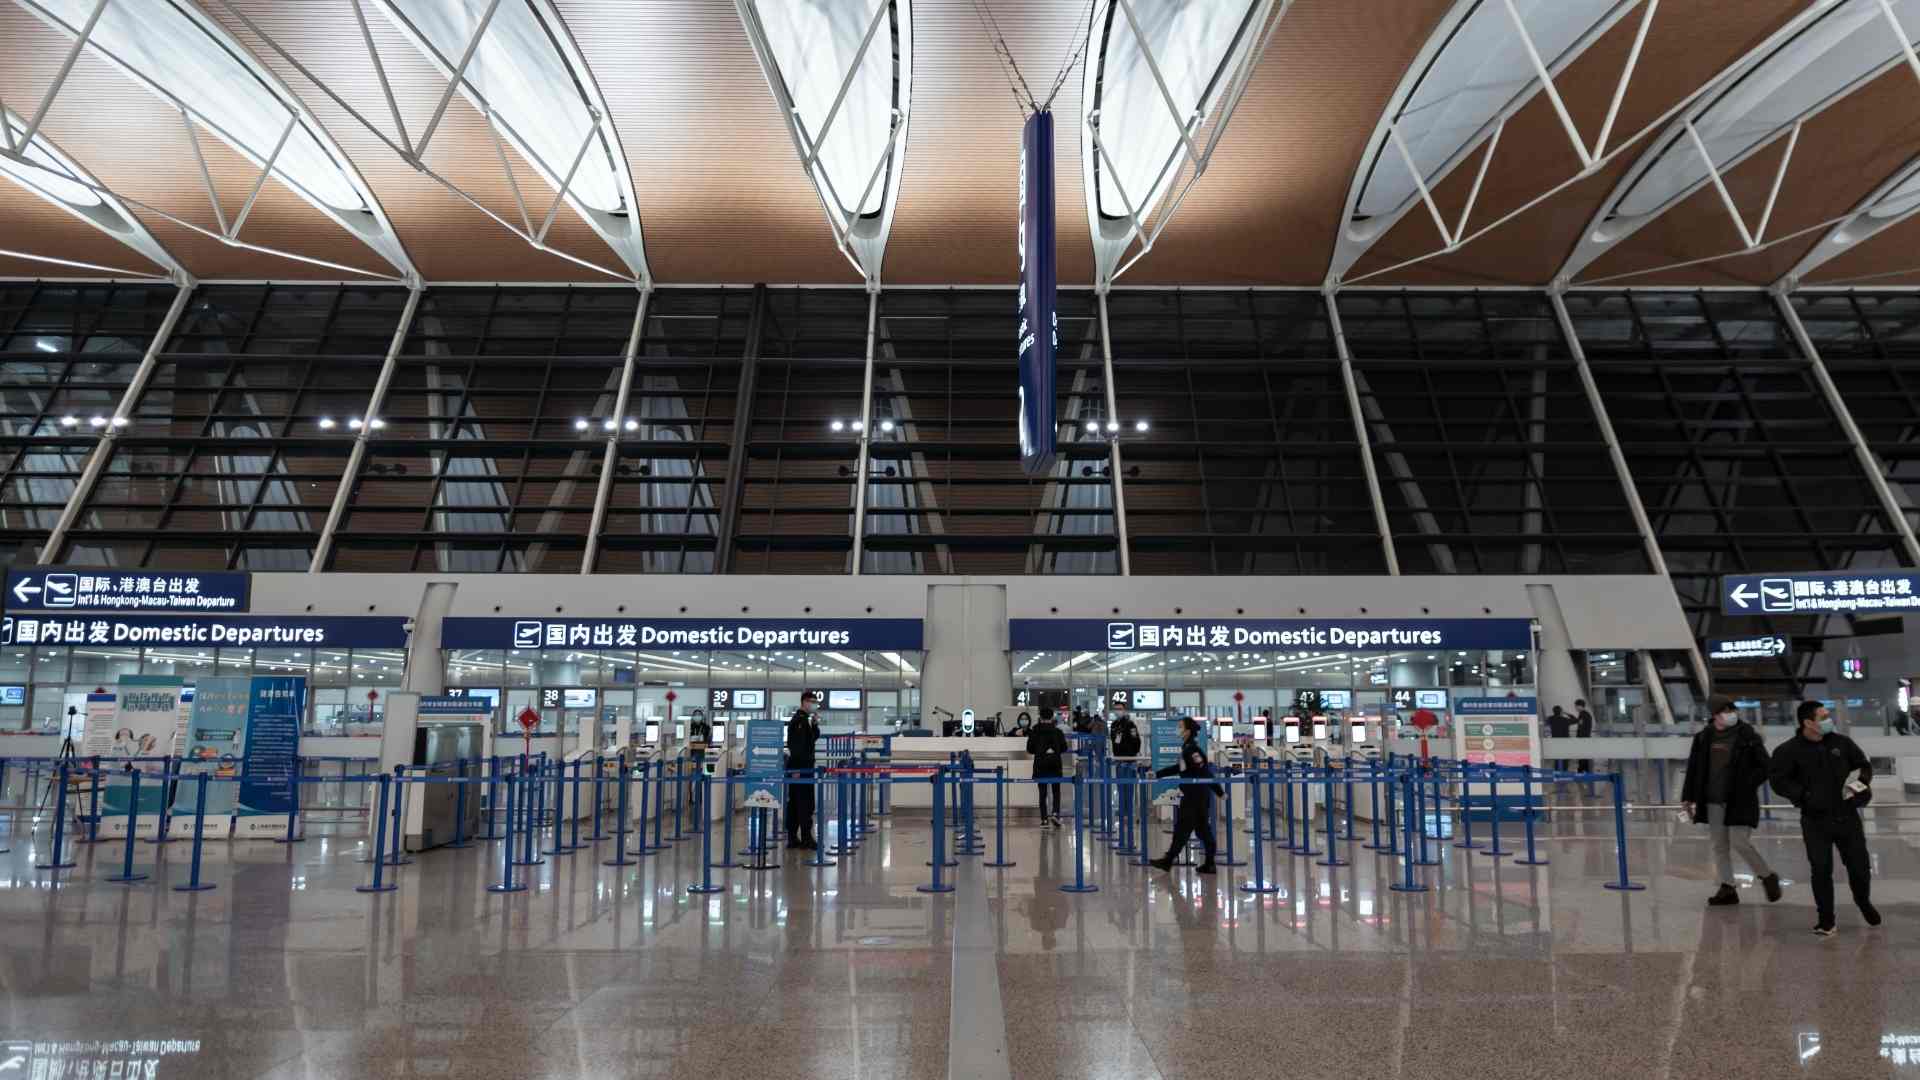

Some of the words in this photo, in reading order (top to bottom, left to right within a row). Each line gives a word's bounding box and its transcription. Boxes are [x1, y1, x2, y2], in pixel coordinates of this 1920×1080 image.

[78, 576, 200, 593] 国际、港澳台出发
[93, 594, 100, 604] &
[101, 593, 195, 608] Hongkong-Macau-Taiwan
[197, 595, 235, 608] Departure
[17, 620, 110, 643] 国内出发
[114, 623, 208, 642] Domestic
[212, 623, 324, 645] Departures
[545, 624, 637, 646] 国内出发
[641, 626, 734, 645] Domestic
[737, 627, 850, 648] Departures
[1139, 625, 1231, 647] 国内出发
[1234, 627, 1327, 646] Domestic
[1330, 627, 1442, 649] Departures
[544, 690, 559, 700] 38
[713, 690, 728, 702] 39
[1112, 691, 1128, 702] 42
[1394, 690, 1410, 702] 44
